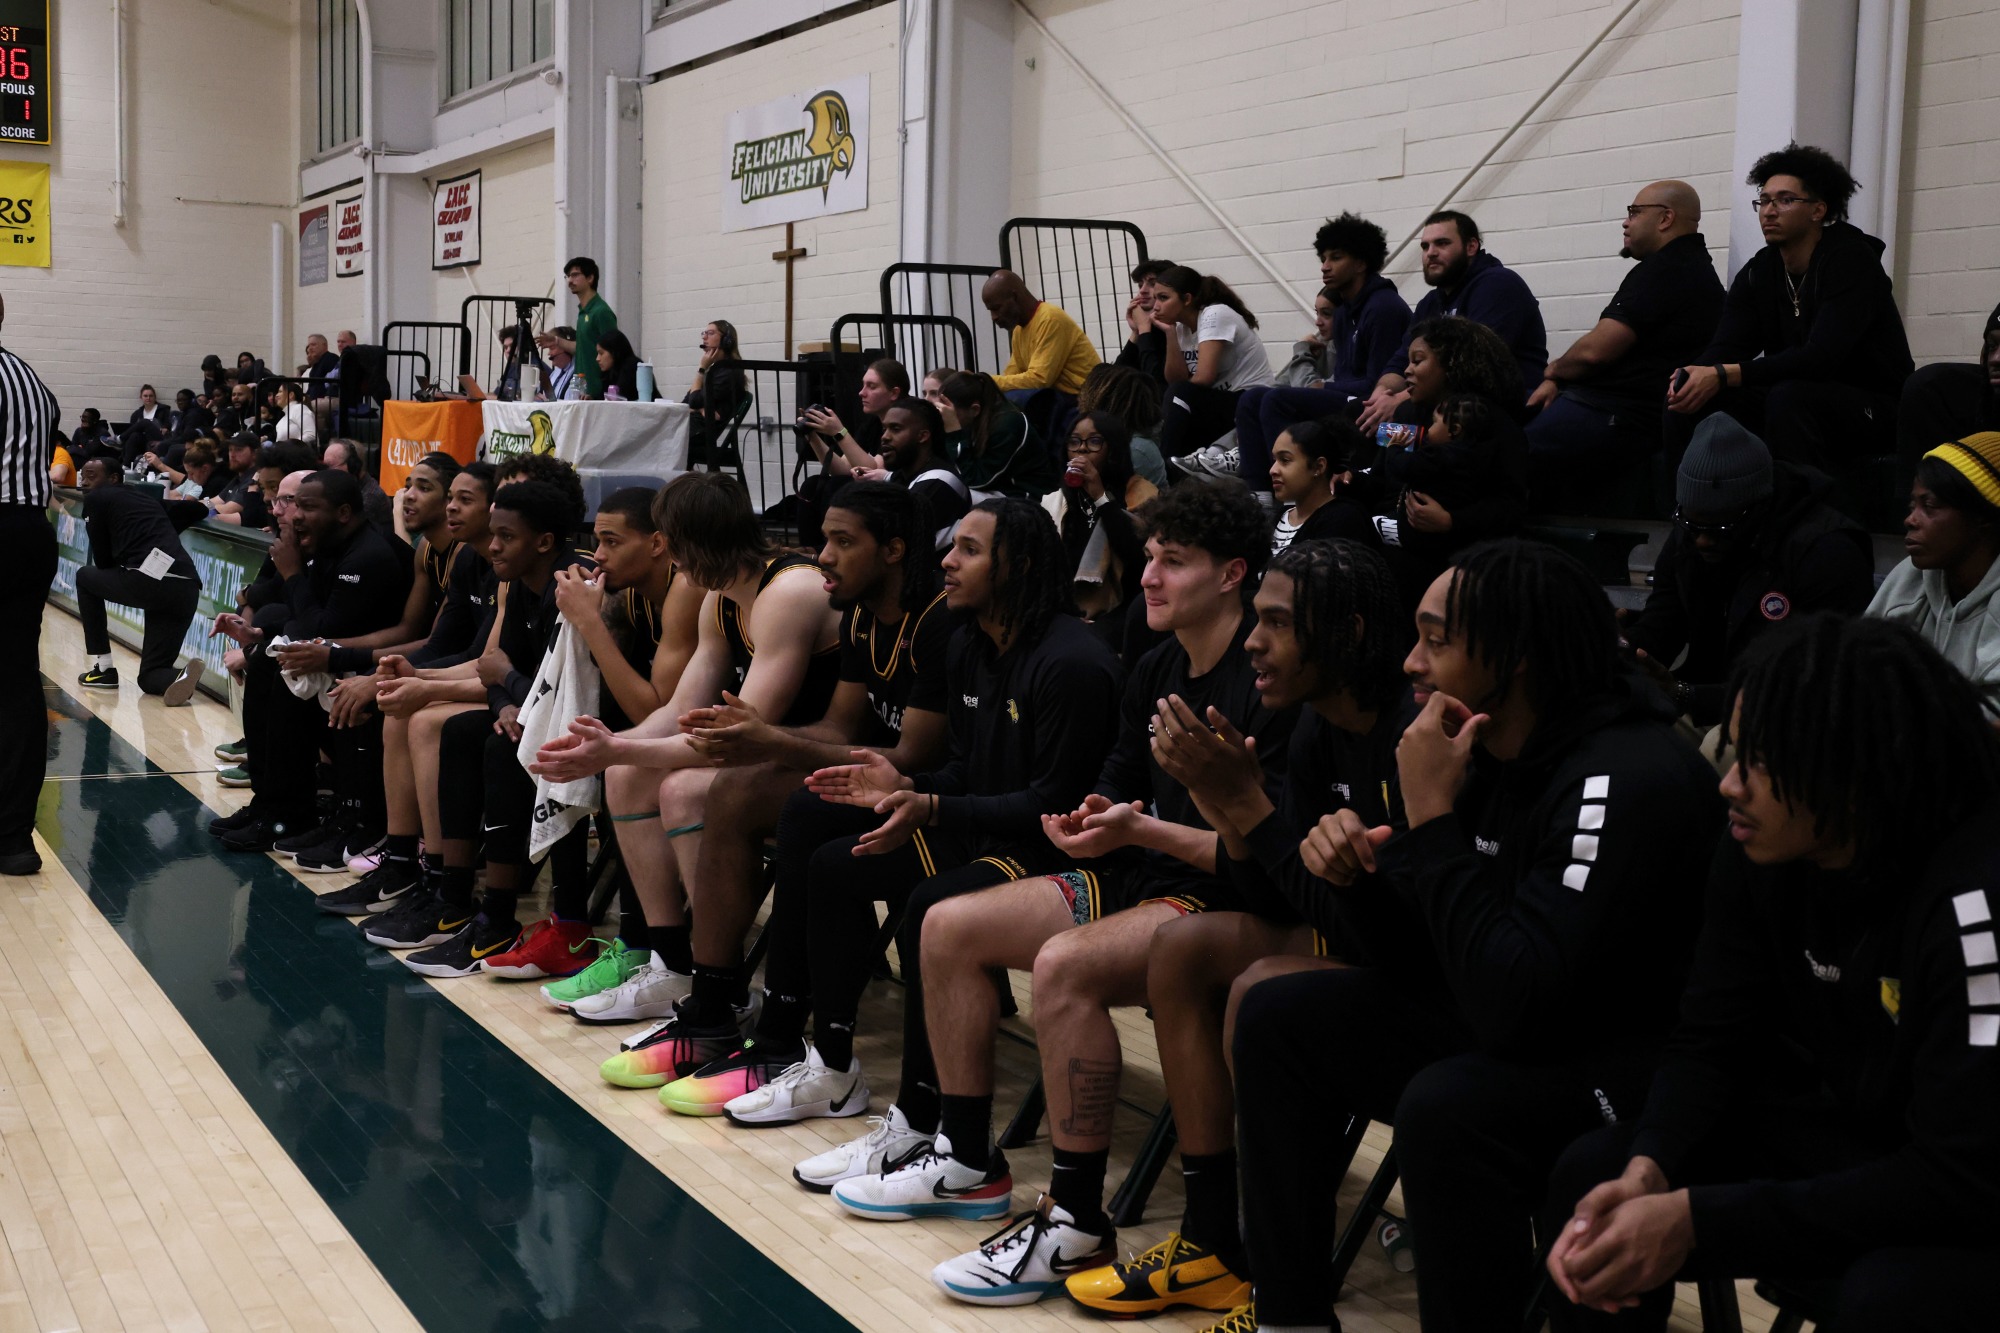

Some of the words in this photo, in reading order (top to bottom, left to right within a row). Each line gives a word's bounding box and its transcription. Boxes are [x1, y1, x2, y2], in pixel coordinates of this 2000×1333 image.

[0, 26, 20, 41] ST
[0, 83, 35, 95] FOULS
[23, 99, 30, 120] 1
[0, 126, 36, 138] SCORE
[733, 131, 804, 177] FELICIAN
[742, 154, 832, 202] UNIVERSITY
[211, 558, 225, 601] OF
